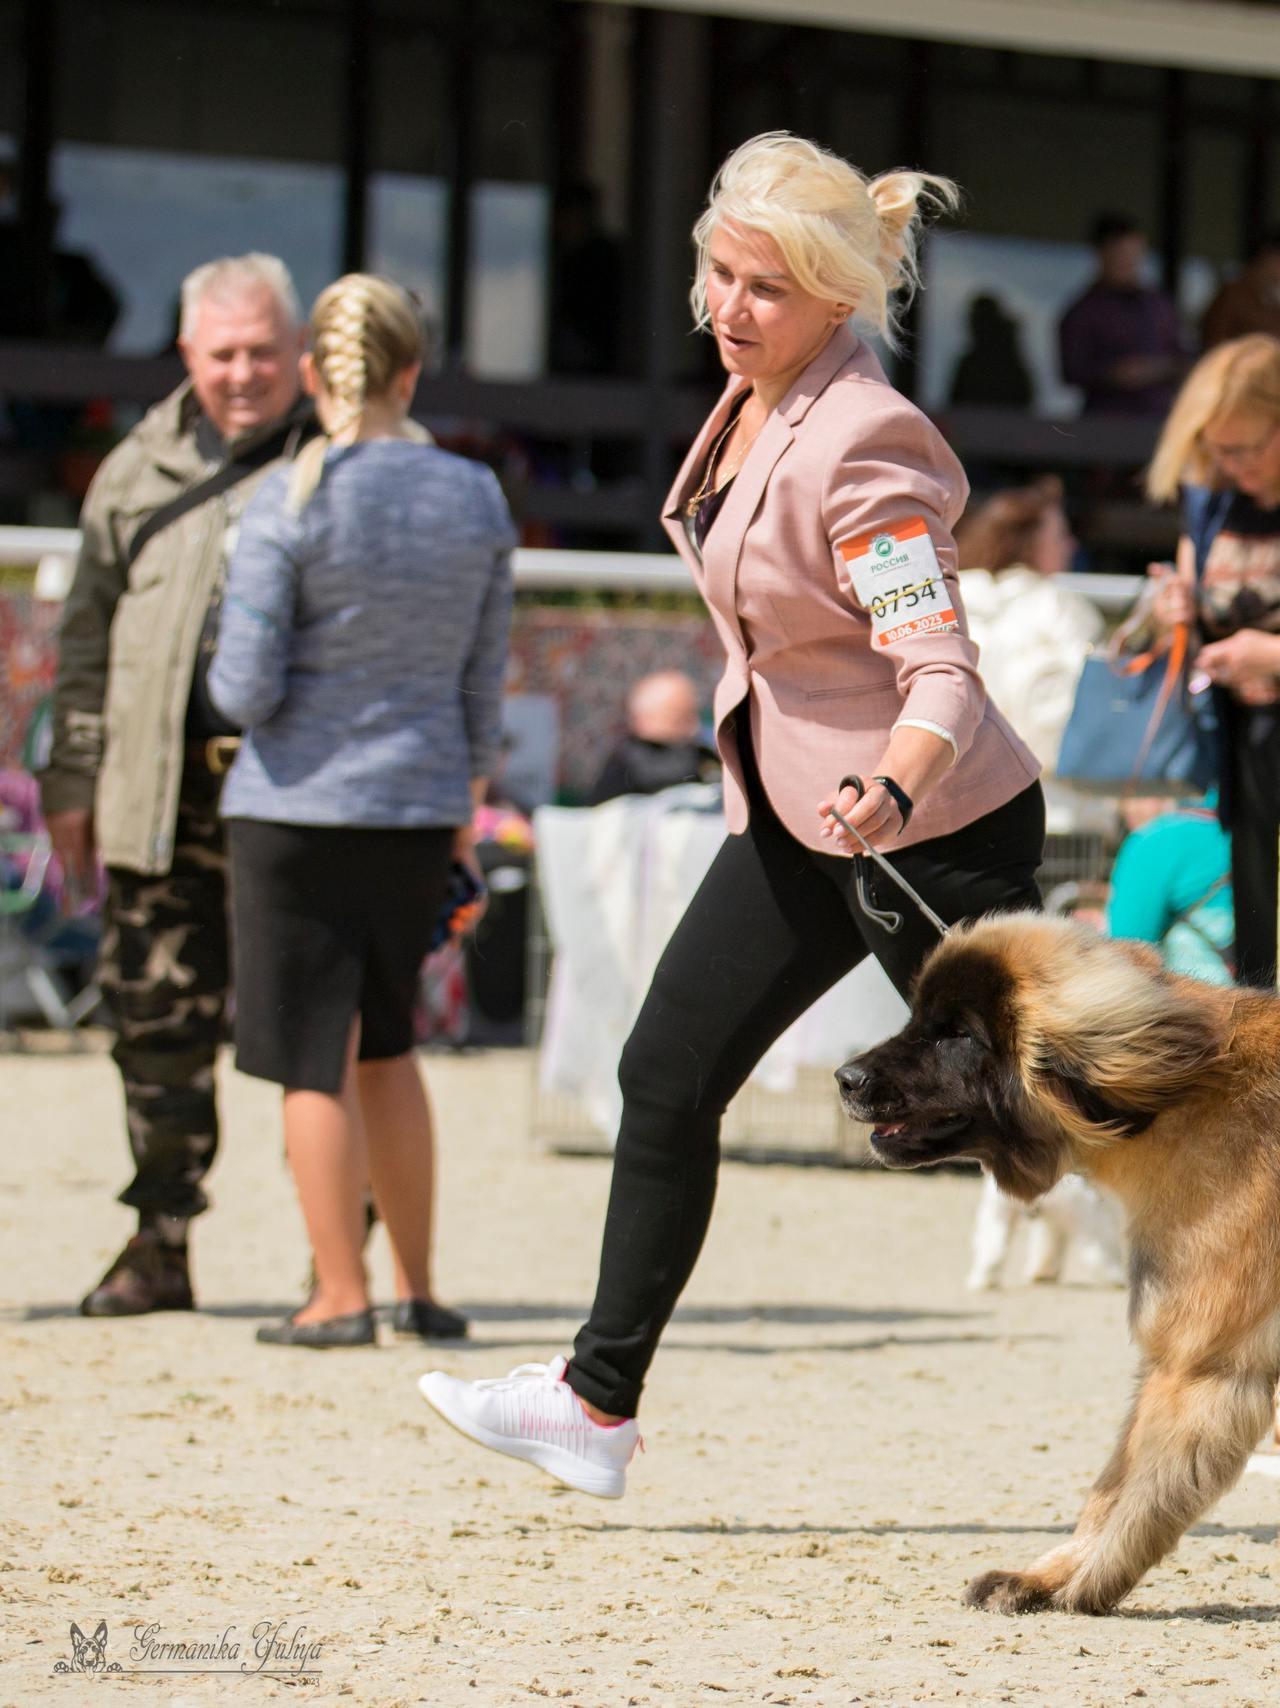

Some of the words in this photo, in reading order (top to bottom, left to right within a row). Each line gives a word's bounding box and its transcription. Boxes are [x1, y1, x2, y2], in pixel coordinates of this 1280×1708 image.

[871, 553, 910, 573] РОССИЯ
[871, 577, 937, 618] 0754
[885, 614, 943, 642] 10.06.2023
